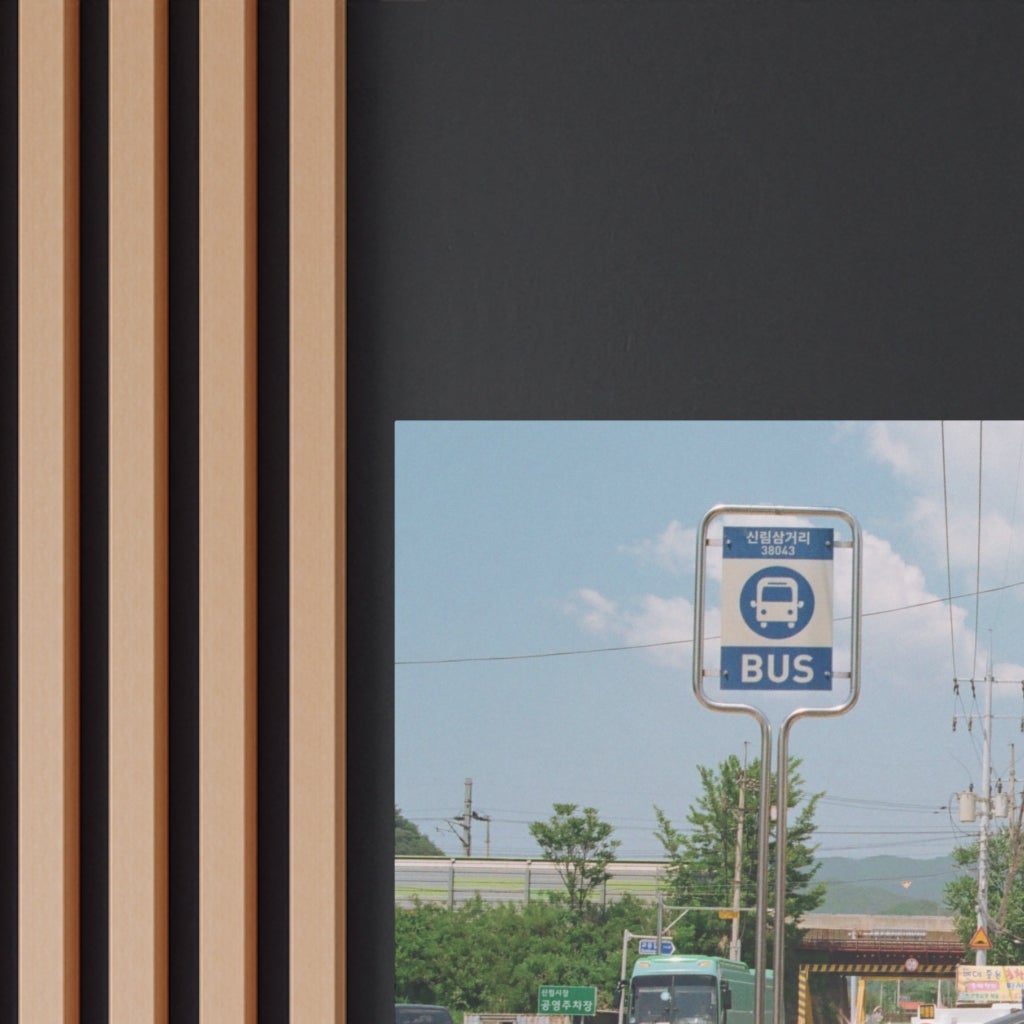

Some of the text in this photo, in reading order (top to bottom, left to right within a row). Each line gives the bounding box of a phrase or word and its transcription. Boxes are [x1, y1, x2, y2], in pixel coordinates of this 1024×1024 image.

[746, 531, 811, 545] 신림삼거리
[761, 545, 796, 556] 38043
[741, 653, 815, 684] BUS
[540, 1000, 592, 1012] 공영주차장
